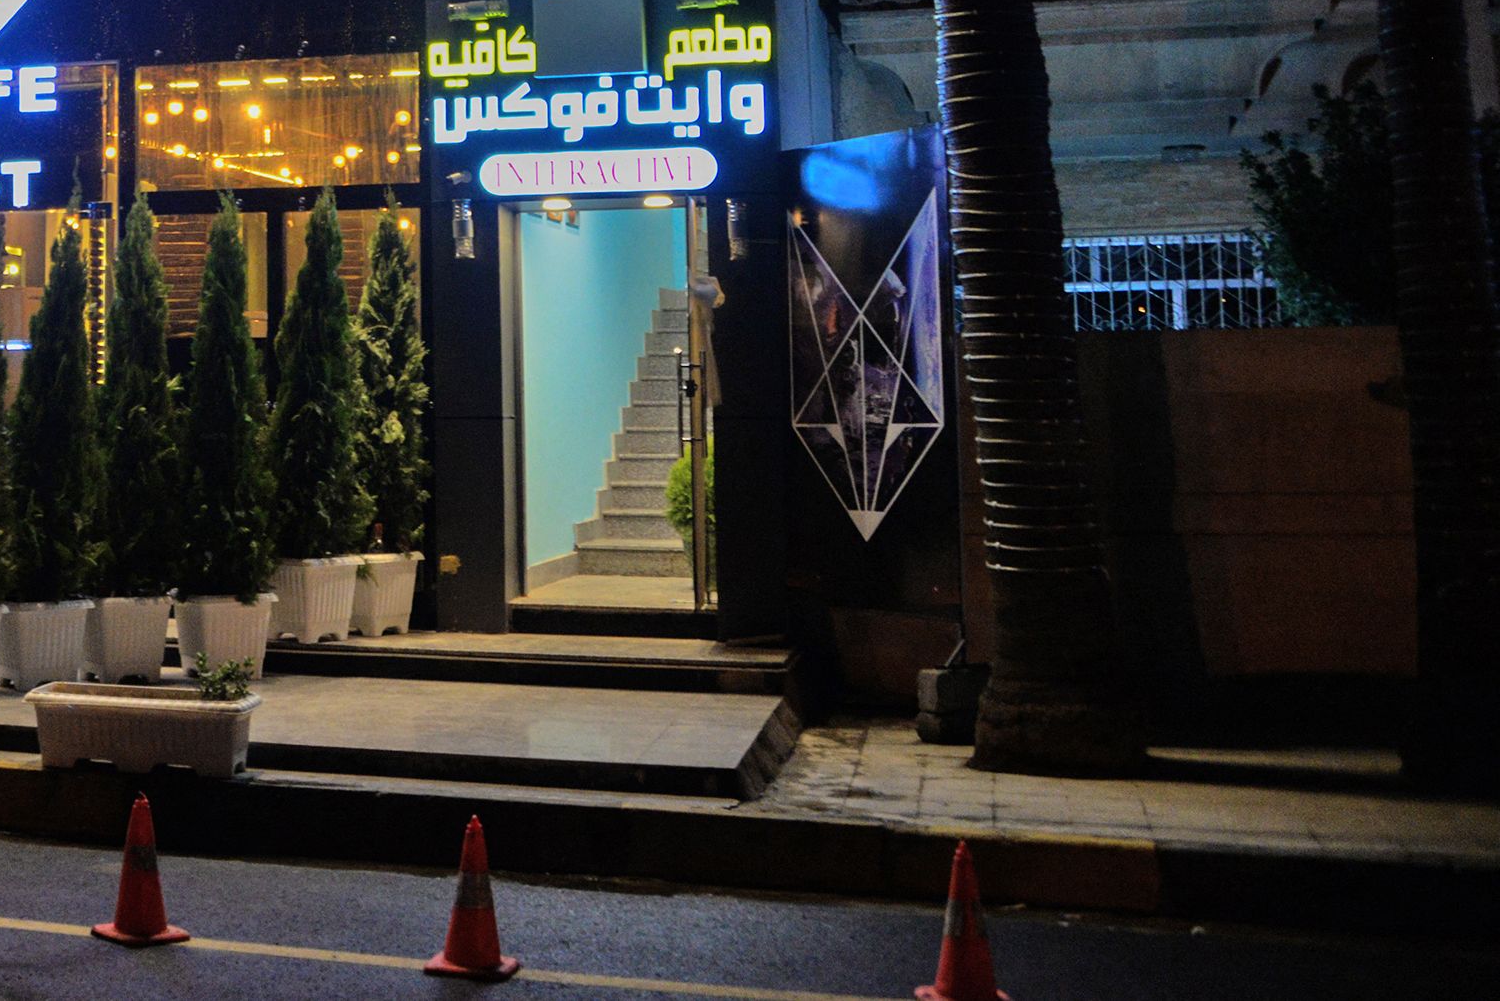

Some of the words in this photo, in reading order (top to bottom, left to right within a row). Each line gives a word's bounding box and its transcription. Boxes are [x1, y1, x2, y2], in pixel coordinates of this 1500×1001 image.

[428, 21, 536, 87] كافيه
[663, 13, 772, 81] مطعم
[433, 74, 619, 143] فوكس
[626, 70, 766, 135] وايت
